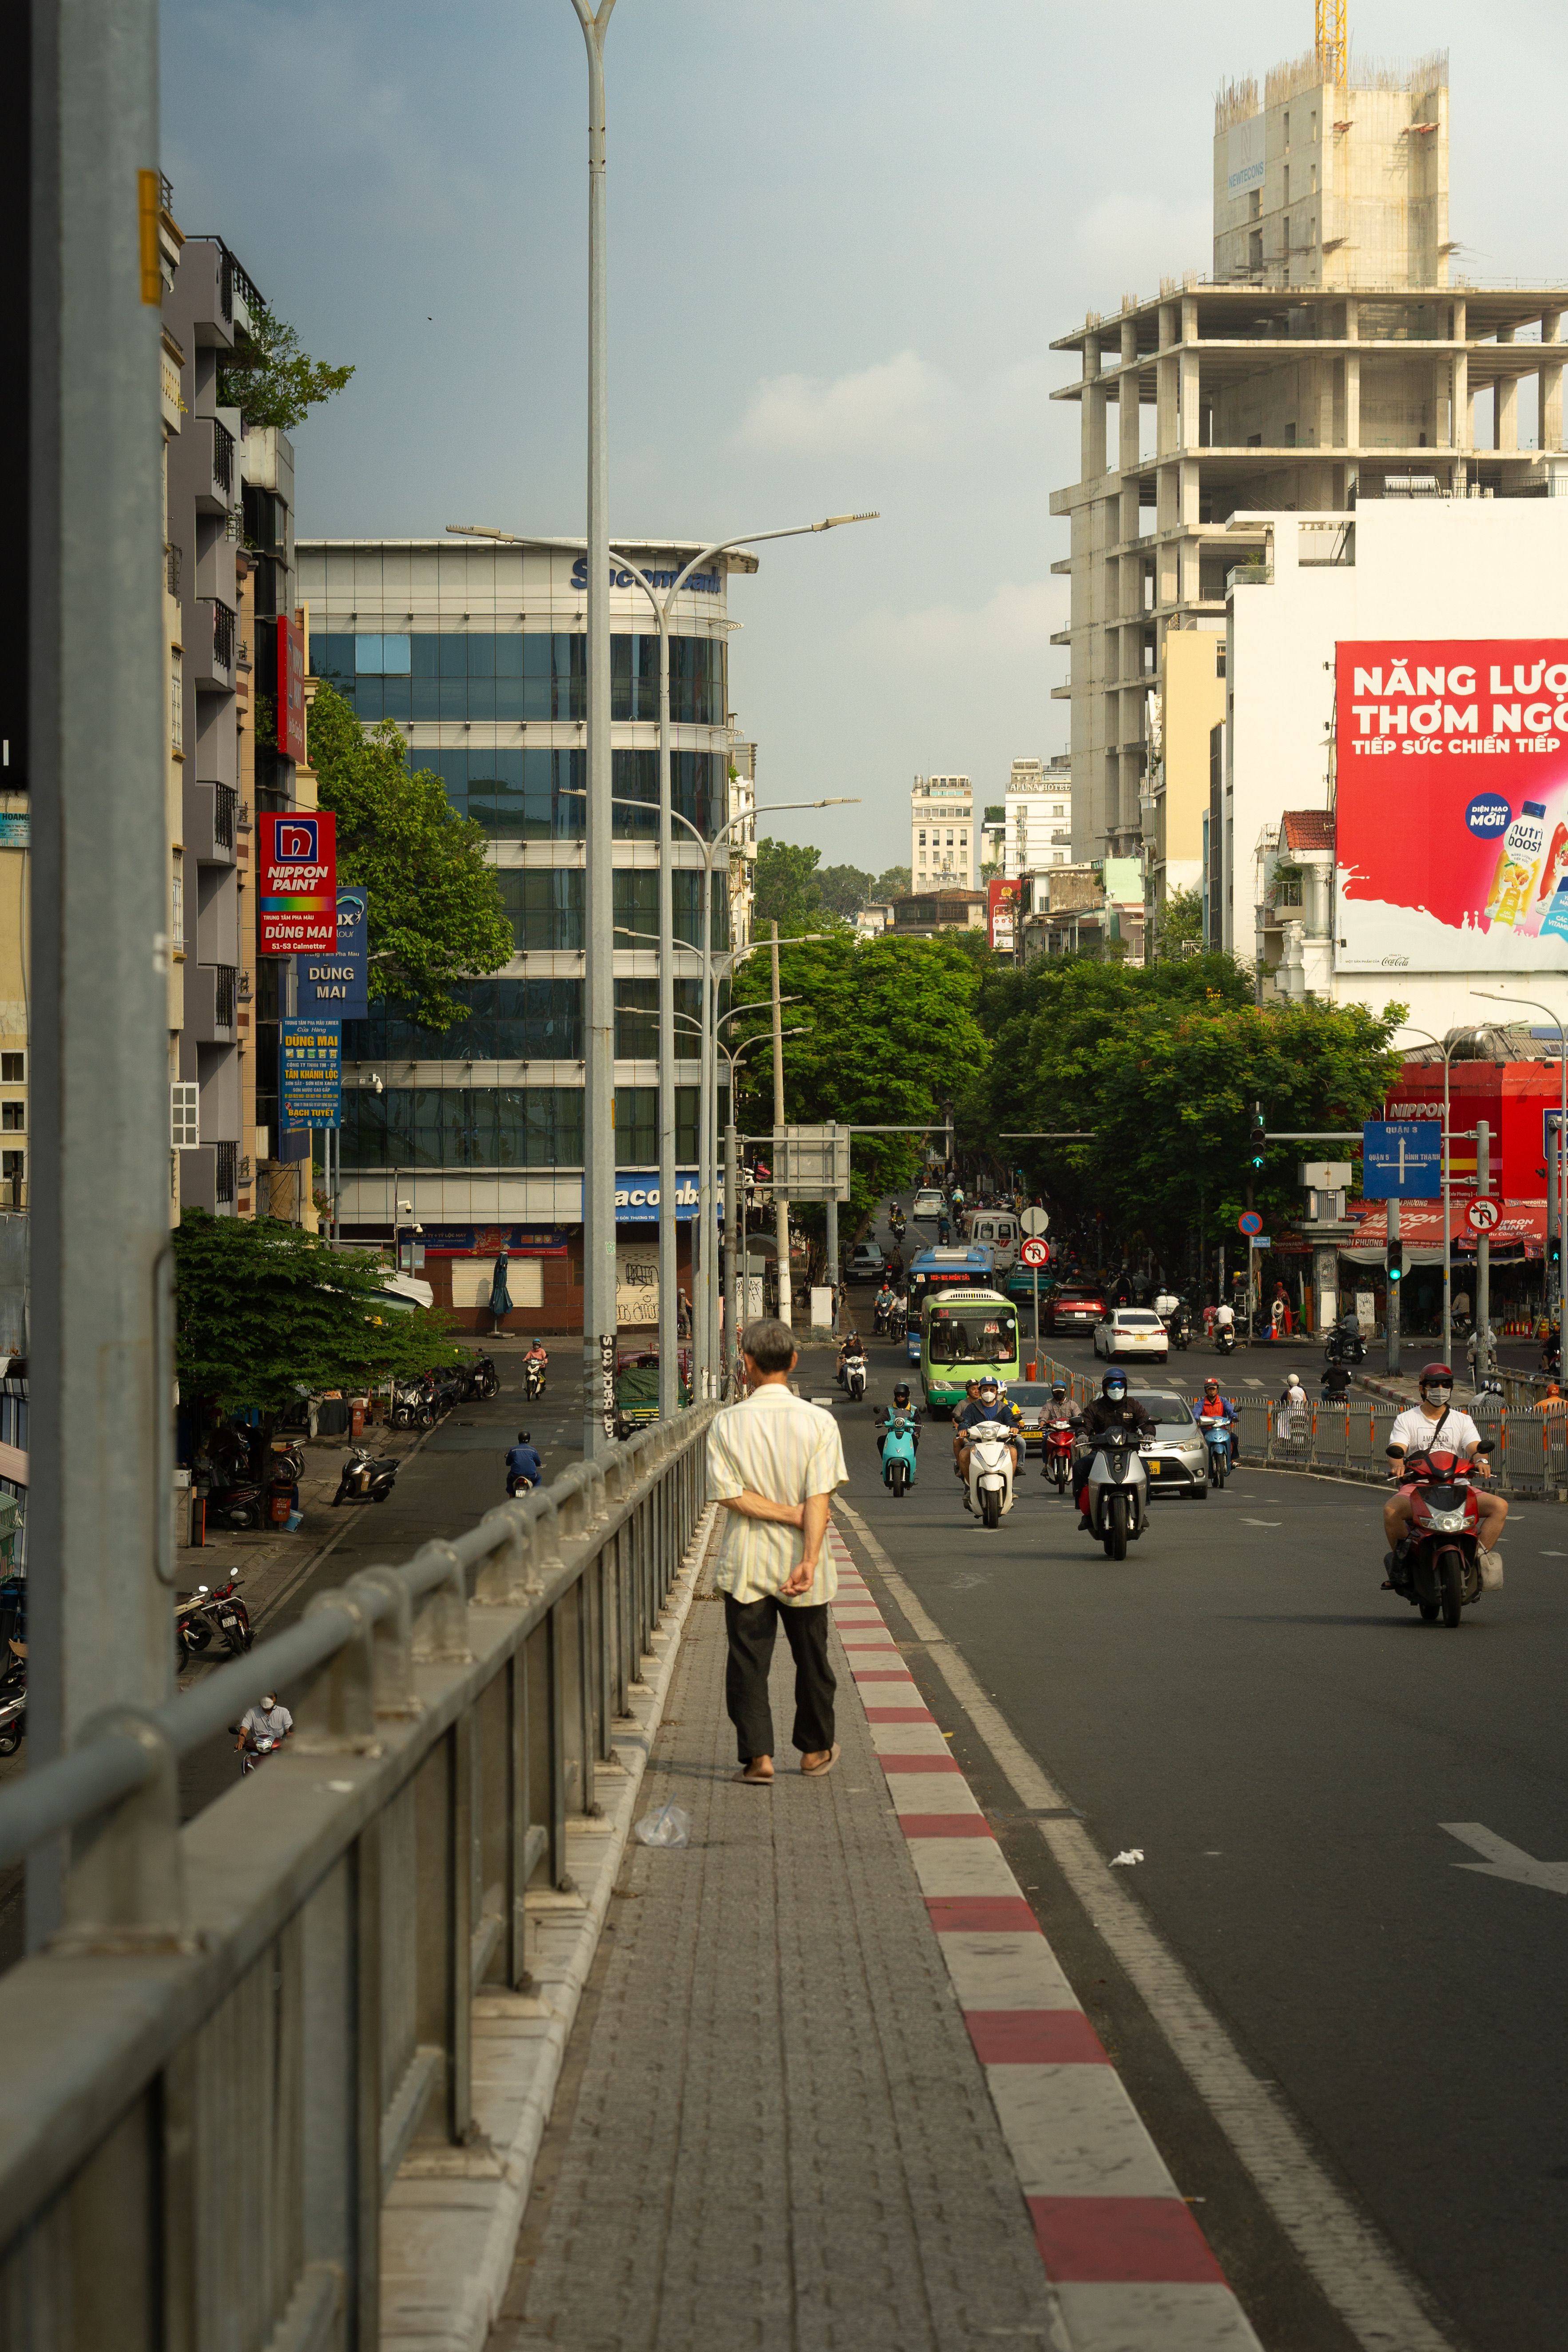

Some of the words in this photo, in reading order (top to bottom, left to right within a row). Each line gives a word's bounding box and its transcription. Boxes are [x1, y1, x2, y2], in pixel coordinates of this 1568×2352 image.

[1229, 161, 1263, 188] NEWTECONS
[1354, 659, 1476, 696] NĂNG
[1352, 699, 1478, 734] THƠM
[1352, 735, 1397, 754] TIẾP
[1402, 736, 1443, 754] SỨC
[1448, 734, 1510, 754] CHIẾN
[1516, 733, 1560, 752] TIẾP
[1472, 805, 1489, 813] DIỆN
[1470, 811, 1505, 826] MỚI!
[1511, 824, 1543, 840] nutri
[1508, 833, 1542, 853] boost
[268, 867, 328, 878] NIPPON
[273, 879, 318, 891] PAINT
[265, 923, 304, 938] DŨNG
[307, 926, 333, 938] MAI
[310, 964, 354, 980] DŨNG
[317, 986, 346, 998] MAI
[285, 1034, 314, 1047] DŨNG
[317, 1036, 338, 1047] MAI
[285, 1068, 298, 1079] TÂN
[300, 1068, 323, 1079] KHÁNH
[325, 1068, 338, 1080] LỘC
[311, 1107, 334, 1116] TUYẾT
[1390, 1103, 1450, 1117] NIPPON
[1369, 1153, 1384, 1162] QUẬN
[1360, 1221, 1422, 1230] PANT
[1355, 1238, 1384, 1247] PHƯƠNG
[986, 1322, 998, 1332] 34
[602, 1349, 614, 1366] to
[603, 1371, 615, 1410] Back
